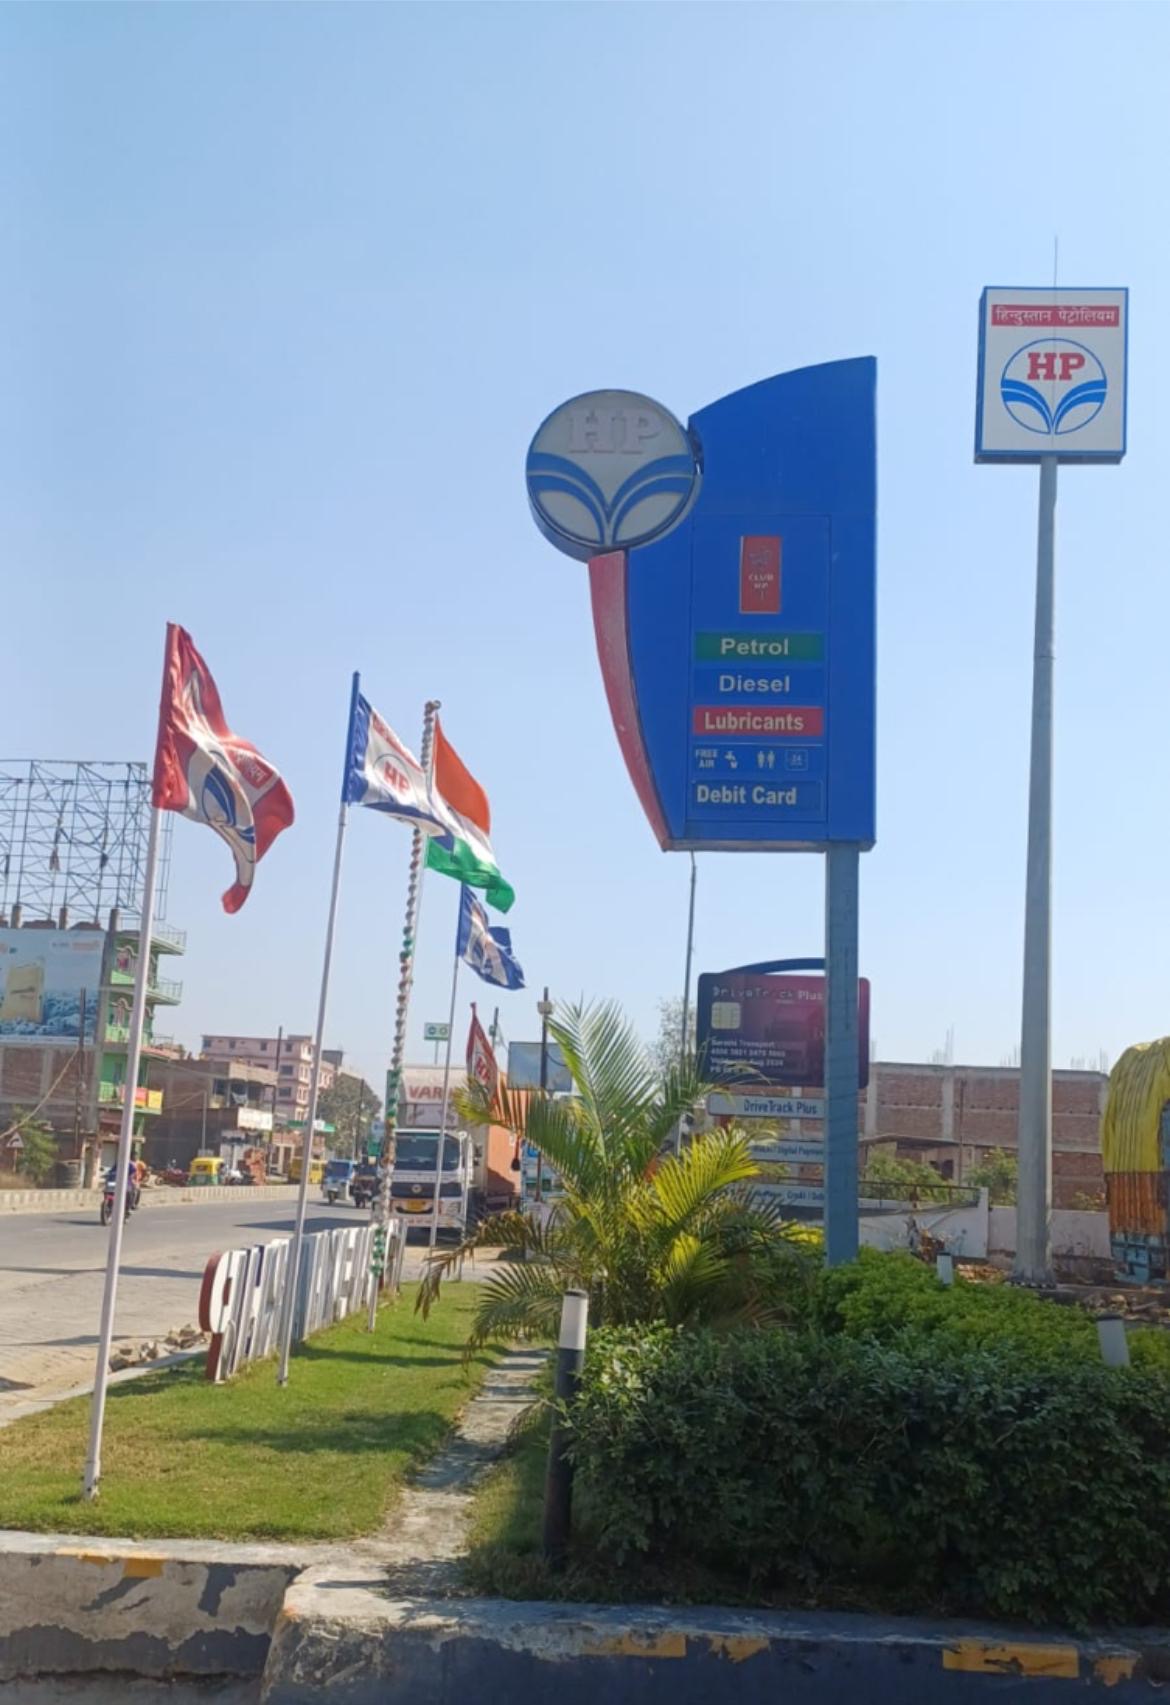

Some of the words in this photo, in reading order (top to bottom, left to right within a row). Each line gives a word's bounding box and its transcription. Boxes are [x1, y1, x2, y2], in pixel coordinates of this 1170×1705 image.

[995, 306, 1052, 326] हिन्दुस्तान
[1058, 306, 1115, 325] पेट्रोलियम
[1027, 351, 1086, 381] HP
[566, 407, 664, 456] HP
[720, 637, 789, 656] Petrol
[718, 674, 791, 693] Diesel
[704, 711, 804, 732] Lubricants
[695, 748, 718, 759] FREE
[698, 759, 715, 769] AIR
[384, 761, 410, 795] HP
[696, 785, 747, 803] Debit
[752, 786, 797, 805] Card
[797, 989, 825, 1000] Plus
[744, 1099, 794, 1113] DriveTrack
[796, 1101, 817, 1115] Plus
